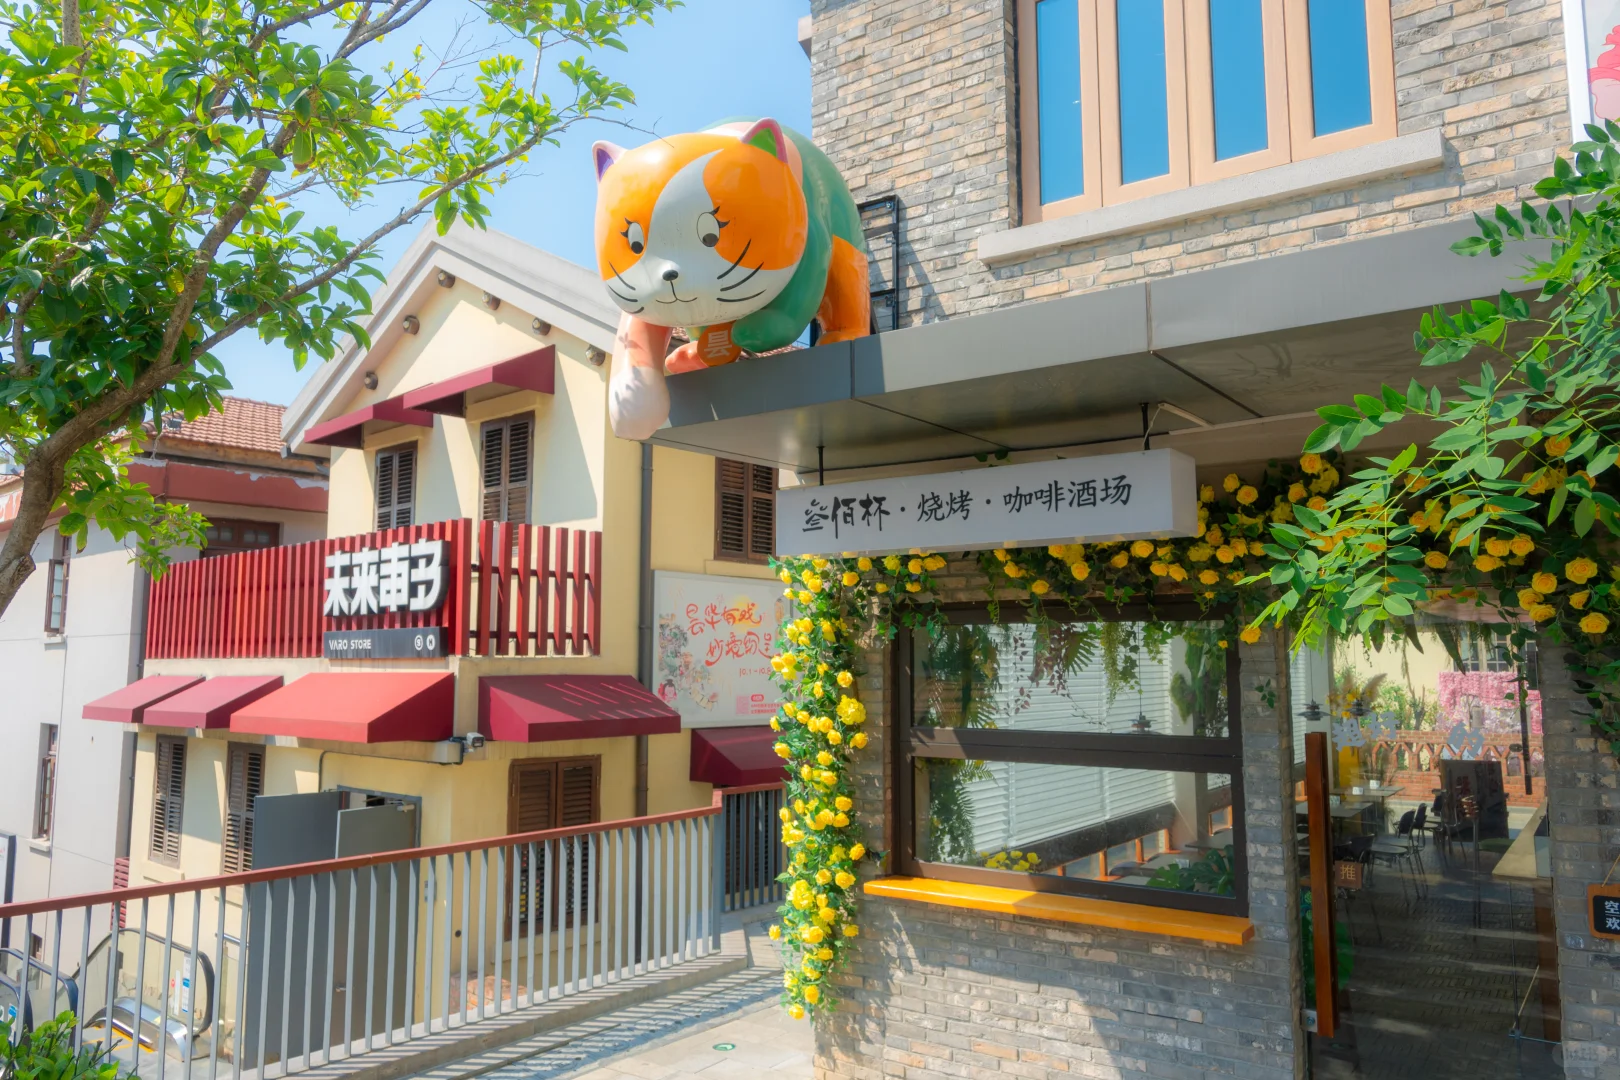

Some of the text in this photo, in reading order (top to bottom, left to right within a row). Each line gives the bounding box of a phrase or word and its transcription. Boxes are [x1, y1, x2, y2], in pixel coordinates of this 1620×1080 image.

[704, 329, 732, 359] 昙
[329, 639, 348, 650] VARO
[350, 639, 371, 650] STORE
[1339, 864, 1356, 880] 推
